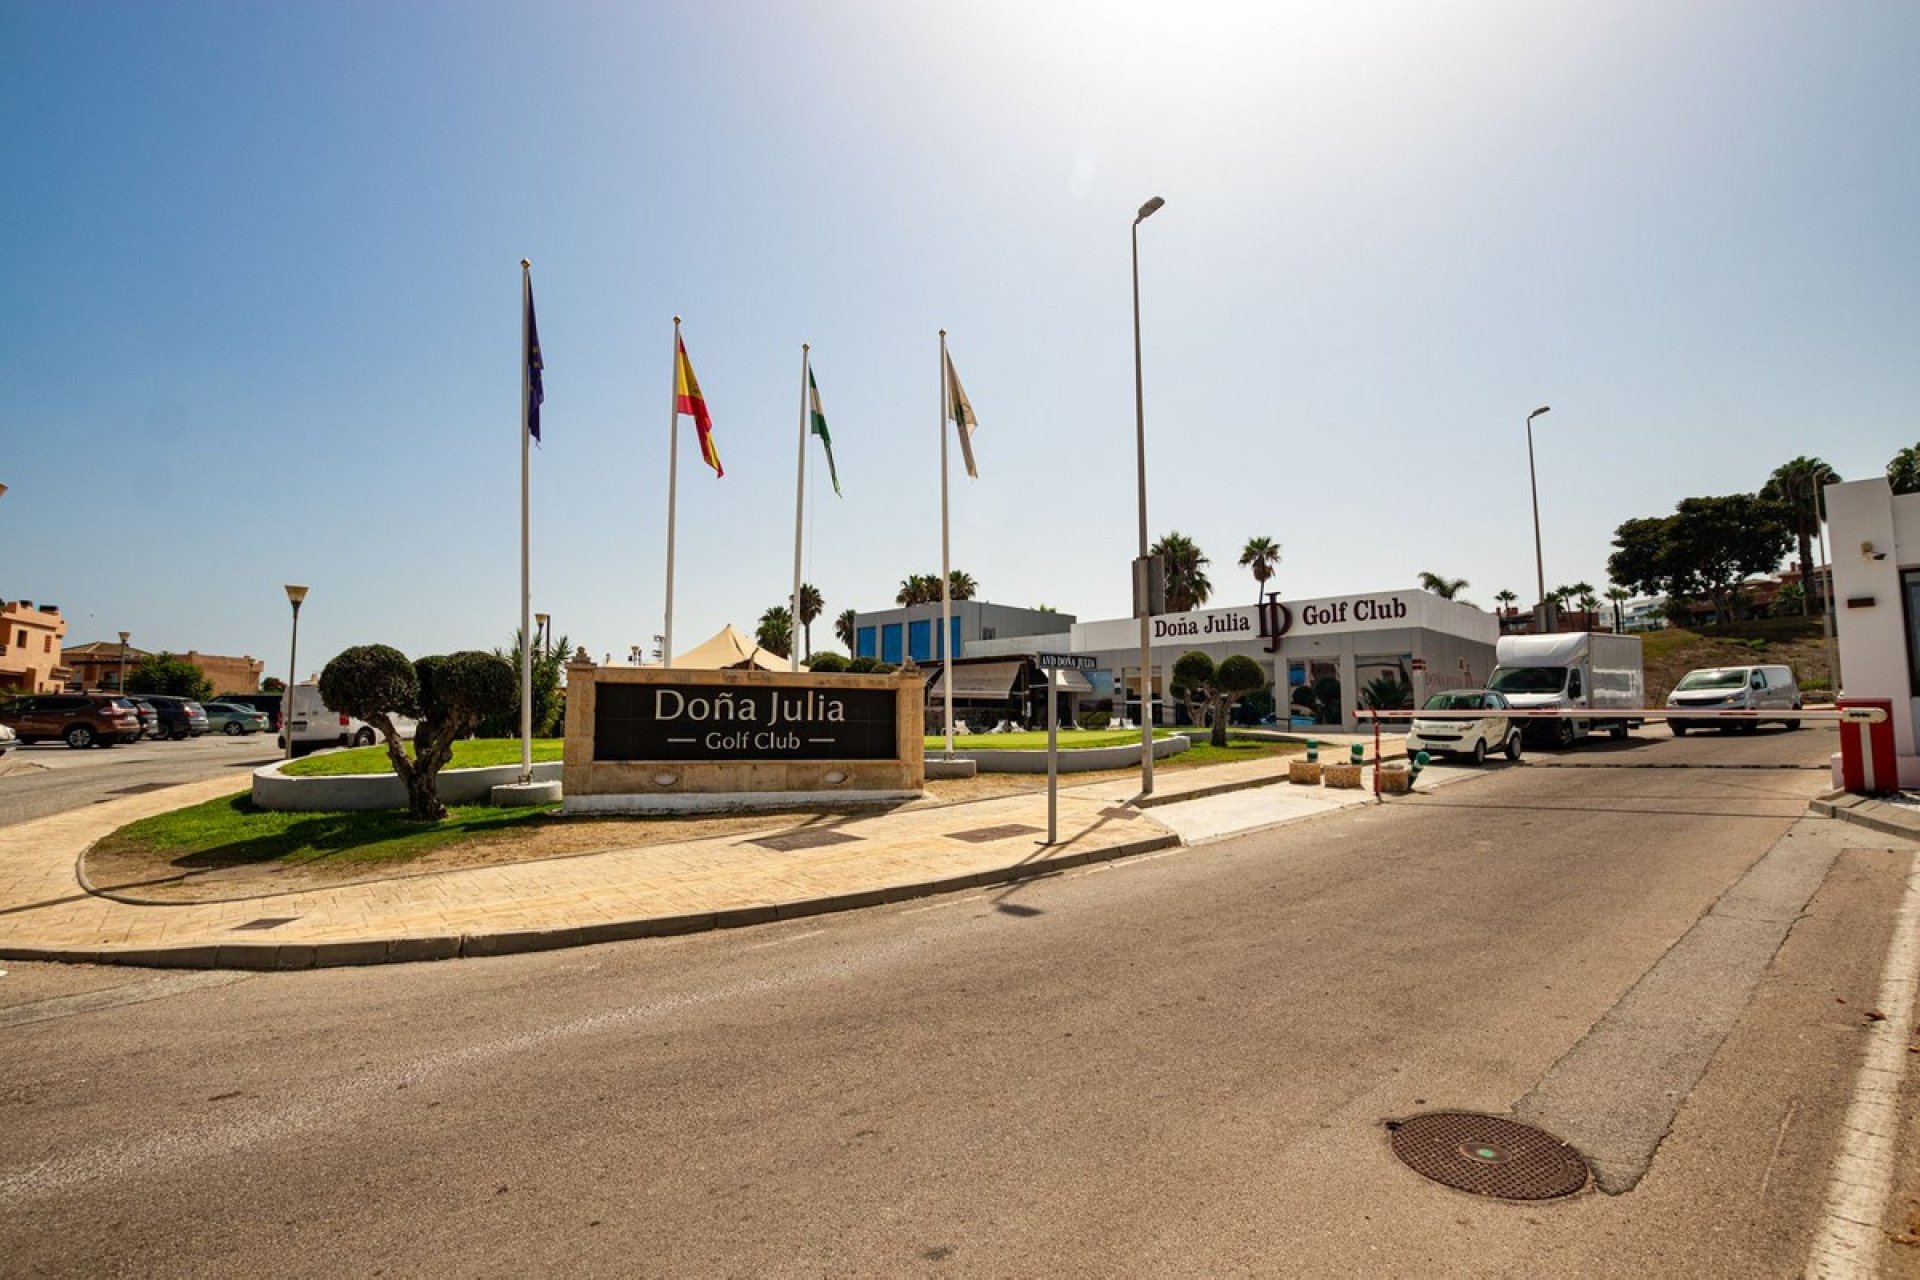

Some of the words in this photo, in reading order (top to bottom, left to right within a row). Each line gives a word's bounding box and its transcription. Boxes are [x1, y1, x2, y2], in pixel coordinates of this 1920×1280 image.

[1155, 617, 1198, 637] Doña
[1204, 612, 1250, 633] Julia
[1303, 602, 1347, 625] Golf
[1354, 598, 1407, 621] Club
[655, 689, 757, 721] Doña
[767, 690, 845, 727] Julia
[706, 731, 749, 750] Golf
[754, 731, 801, 750] Club
